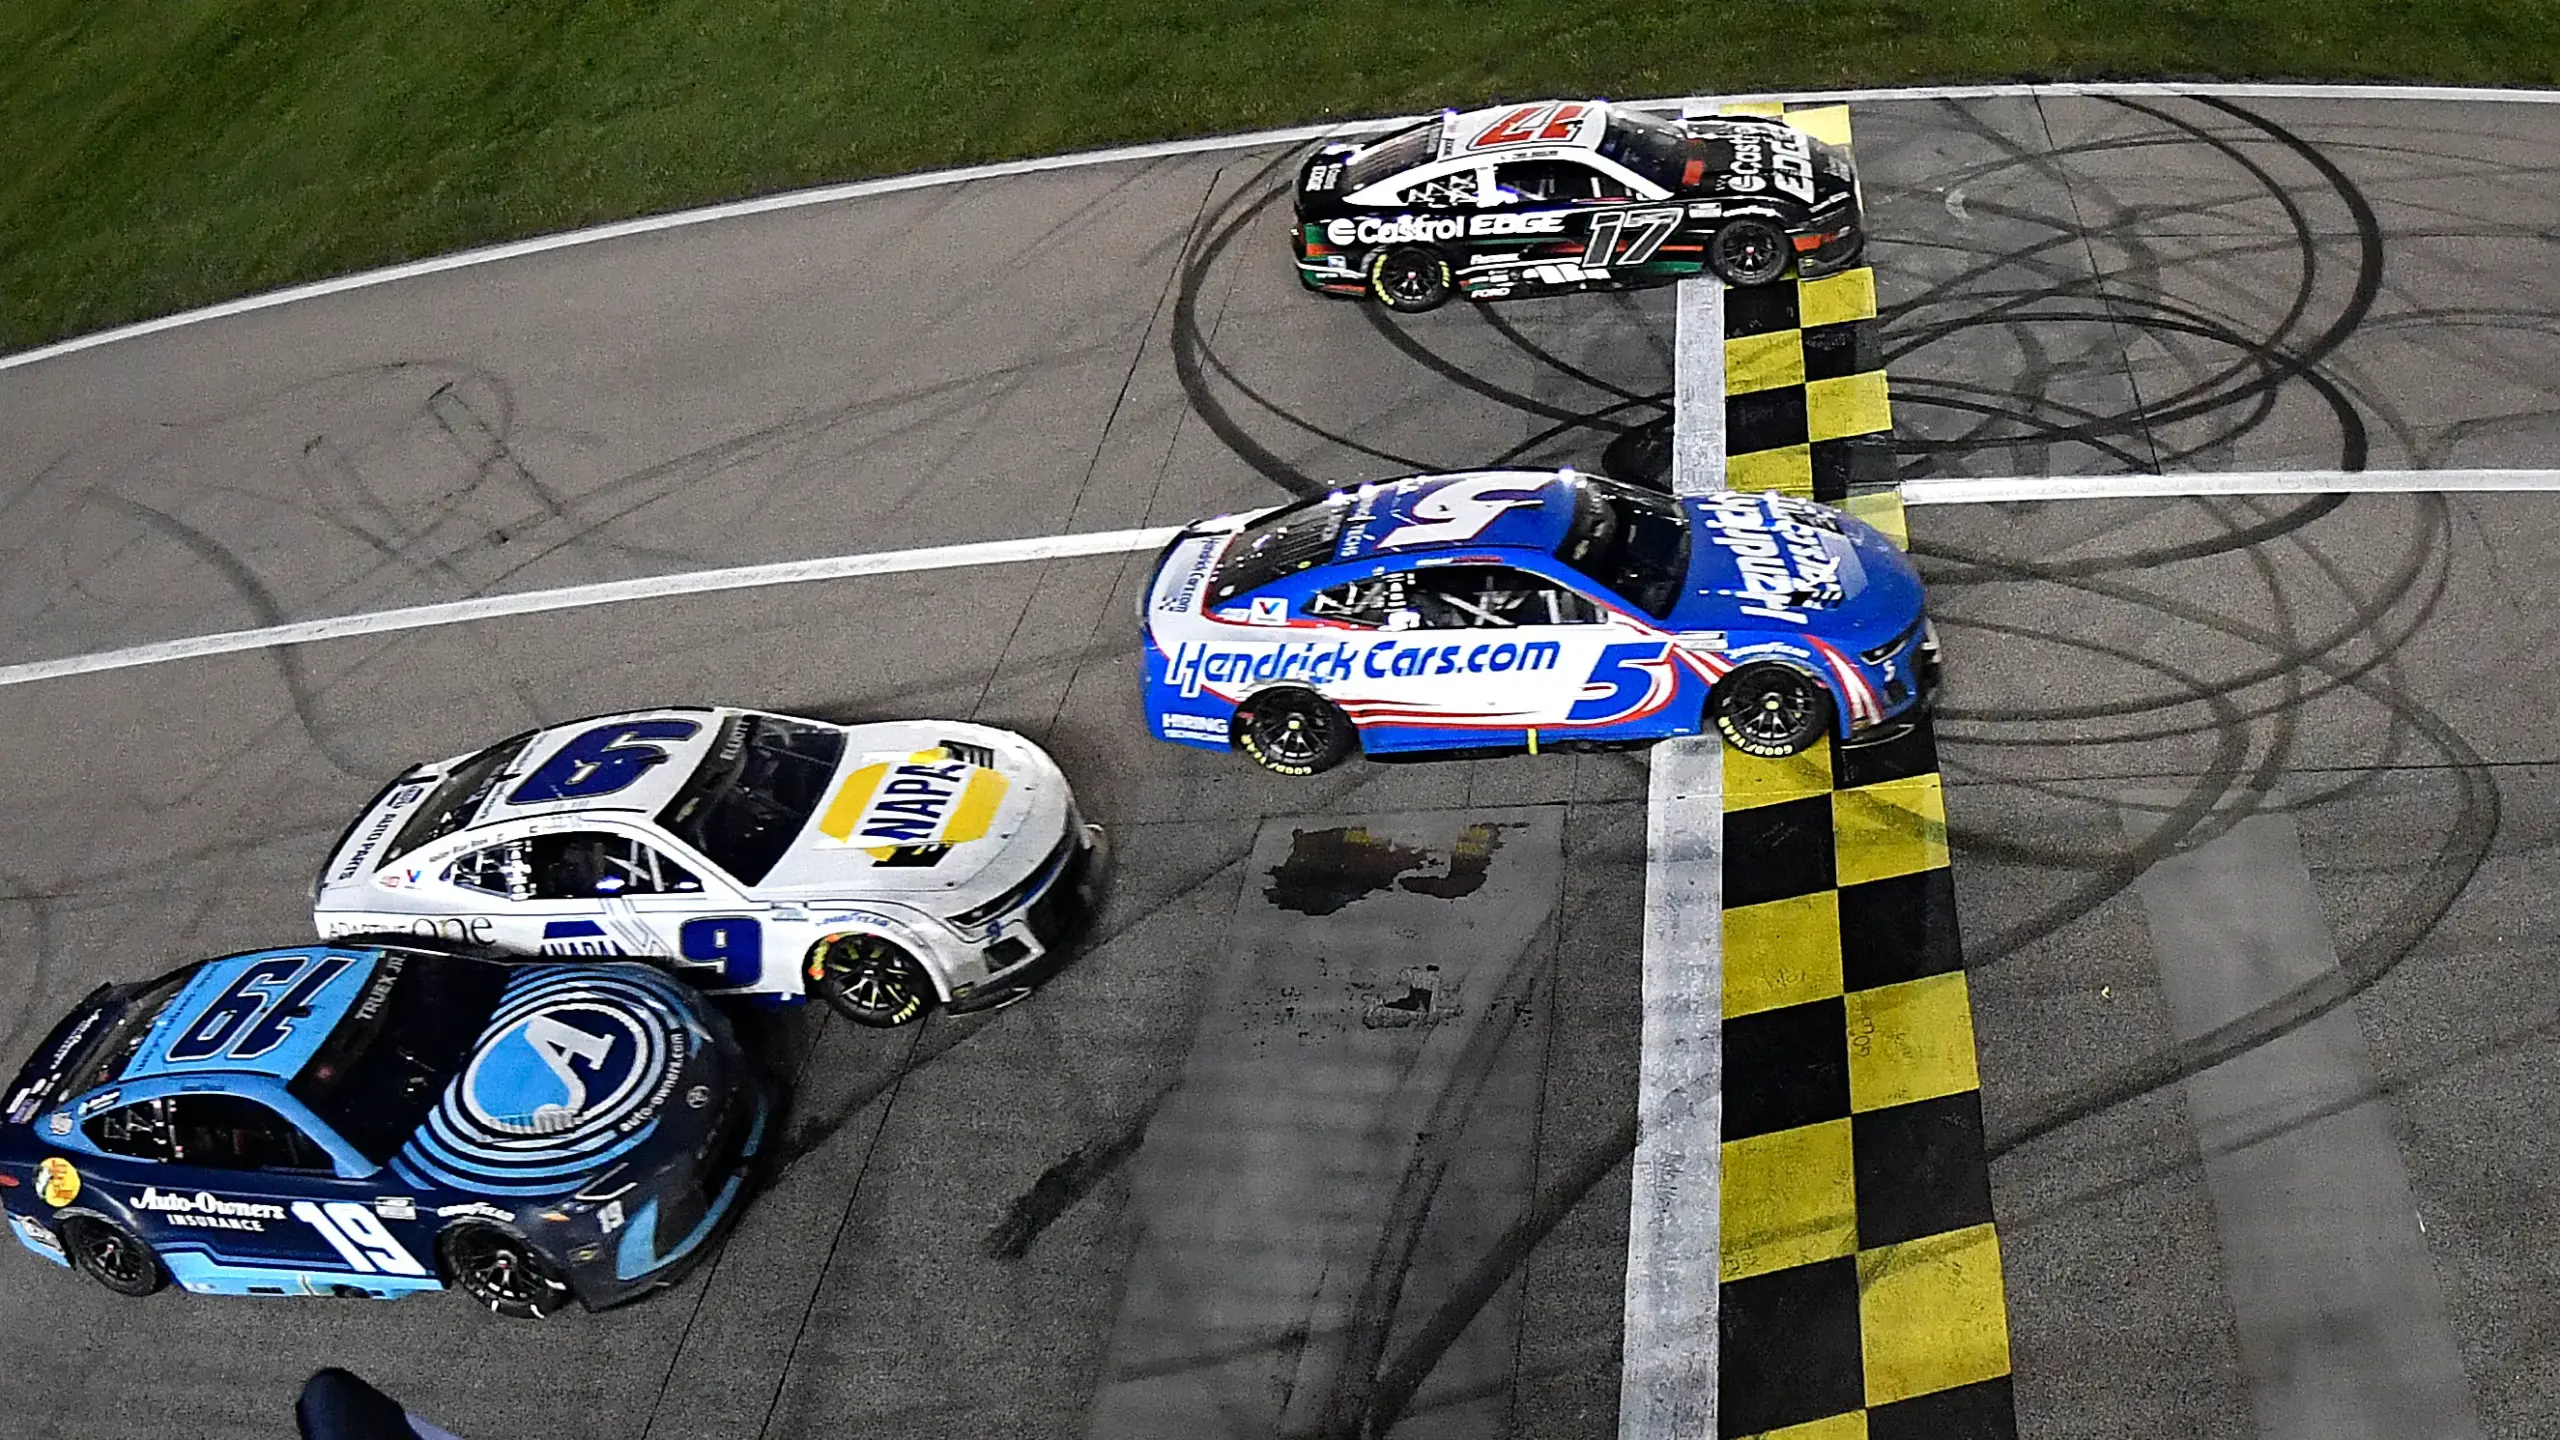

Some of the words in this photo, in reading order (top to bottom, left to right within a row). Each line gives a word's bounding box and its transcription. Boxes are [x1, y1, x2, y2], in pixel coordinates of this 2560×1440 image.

[1357, 214, 1464, 245] Castrol
[1469, 214, 1565, 236] EDGE
[1582, 207, 1684, 268] 17
[1375, 471, 1557, 549] 5
[1165, 640, 1562, 696] HendrickCars.com
[1564, 641, 1670, 722] 5
[505, 718, 703, 806] 9
[680, 915, 763, 990] 9
[164, 955, 358, 1062] 19
[355, 970, 398, 1022] TRUEX
[130, 1186, 288, 1220] Auto-Owners
[167, 1213, 266, 1233] INSURANCE
[291, 1201, 428, 1275] 19
